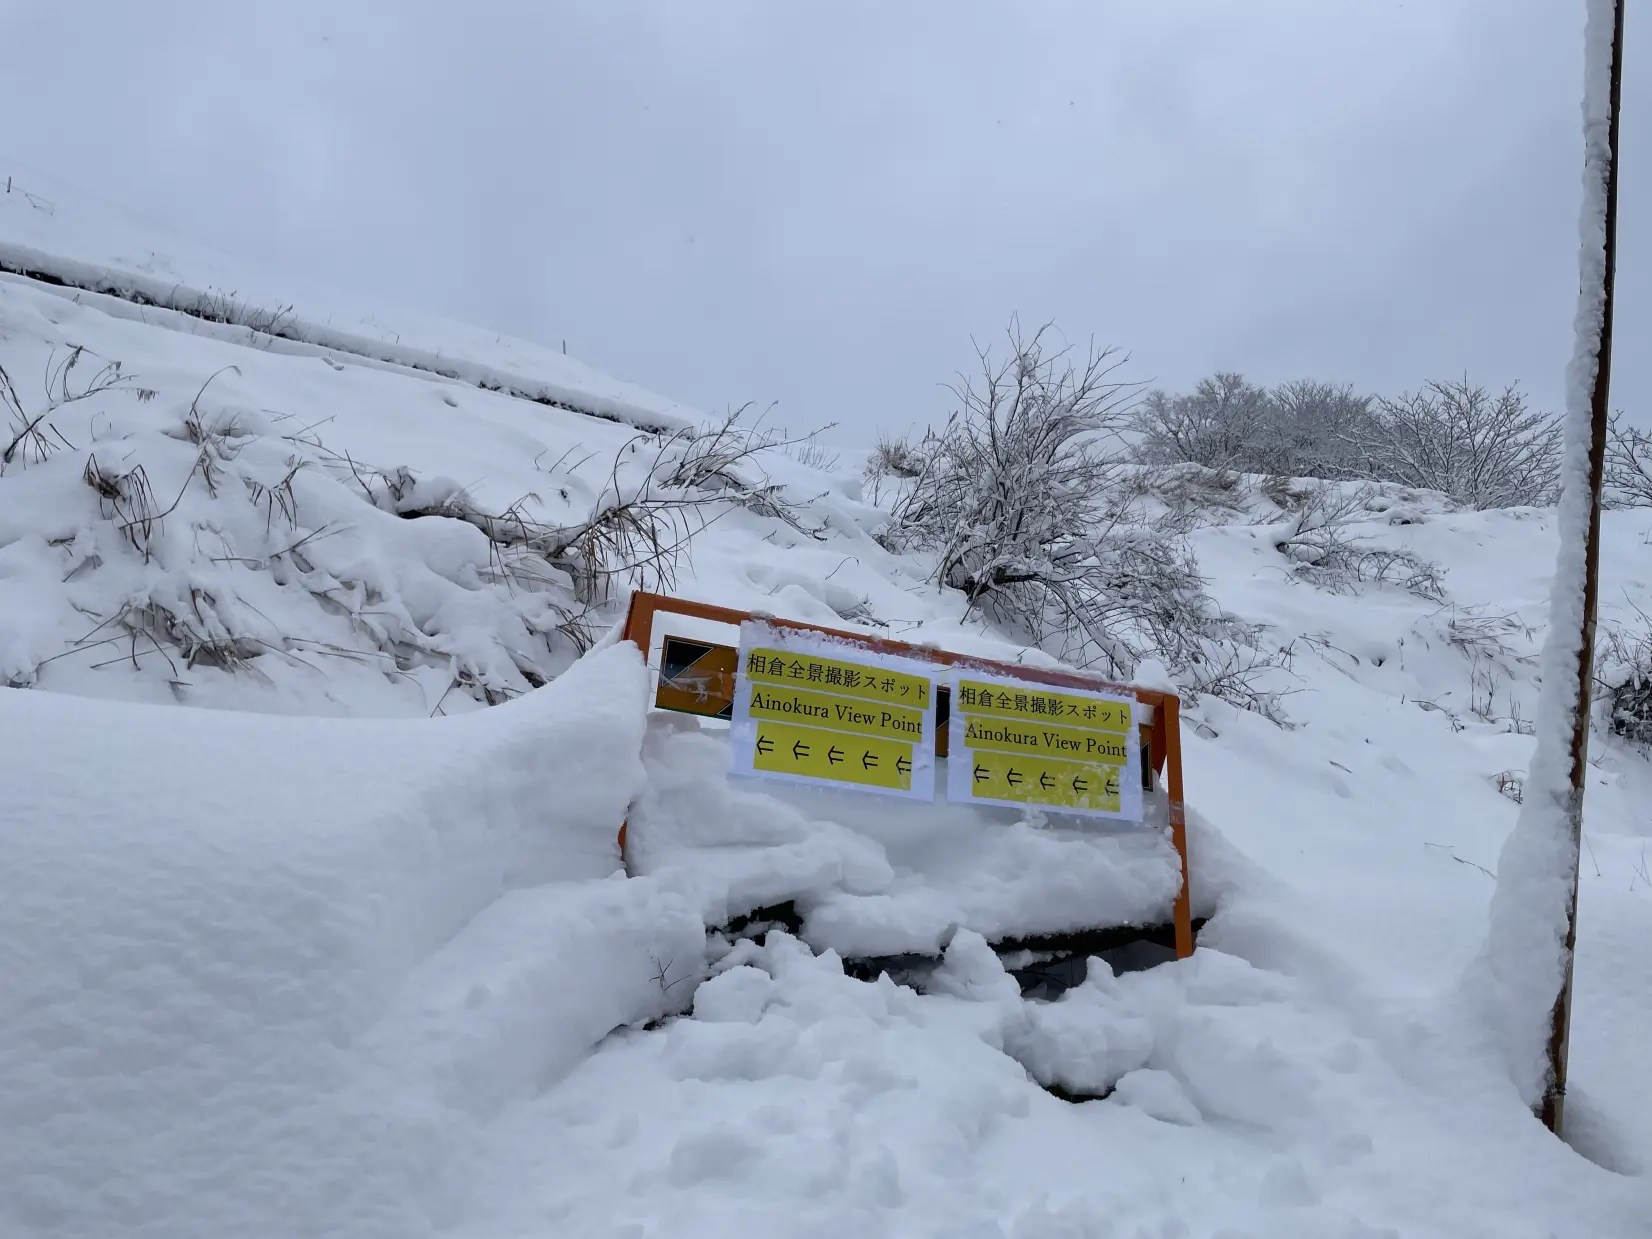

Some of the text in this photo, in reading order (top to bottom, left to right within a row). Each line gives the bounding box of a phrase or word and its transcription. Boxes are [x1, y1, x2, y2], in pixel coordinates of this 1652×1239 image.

[747, 653, 927, 700] 相倉全景撮影スポット
[750, 692, 923, 734] Ainokura View Point
[959, 686, 1129, 725] 相倉全景撮影スポット
[965, 723, 1128, 758] Ainokura View Point
